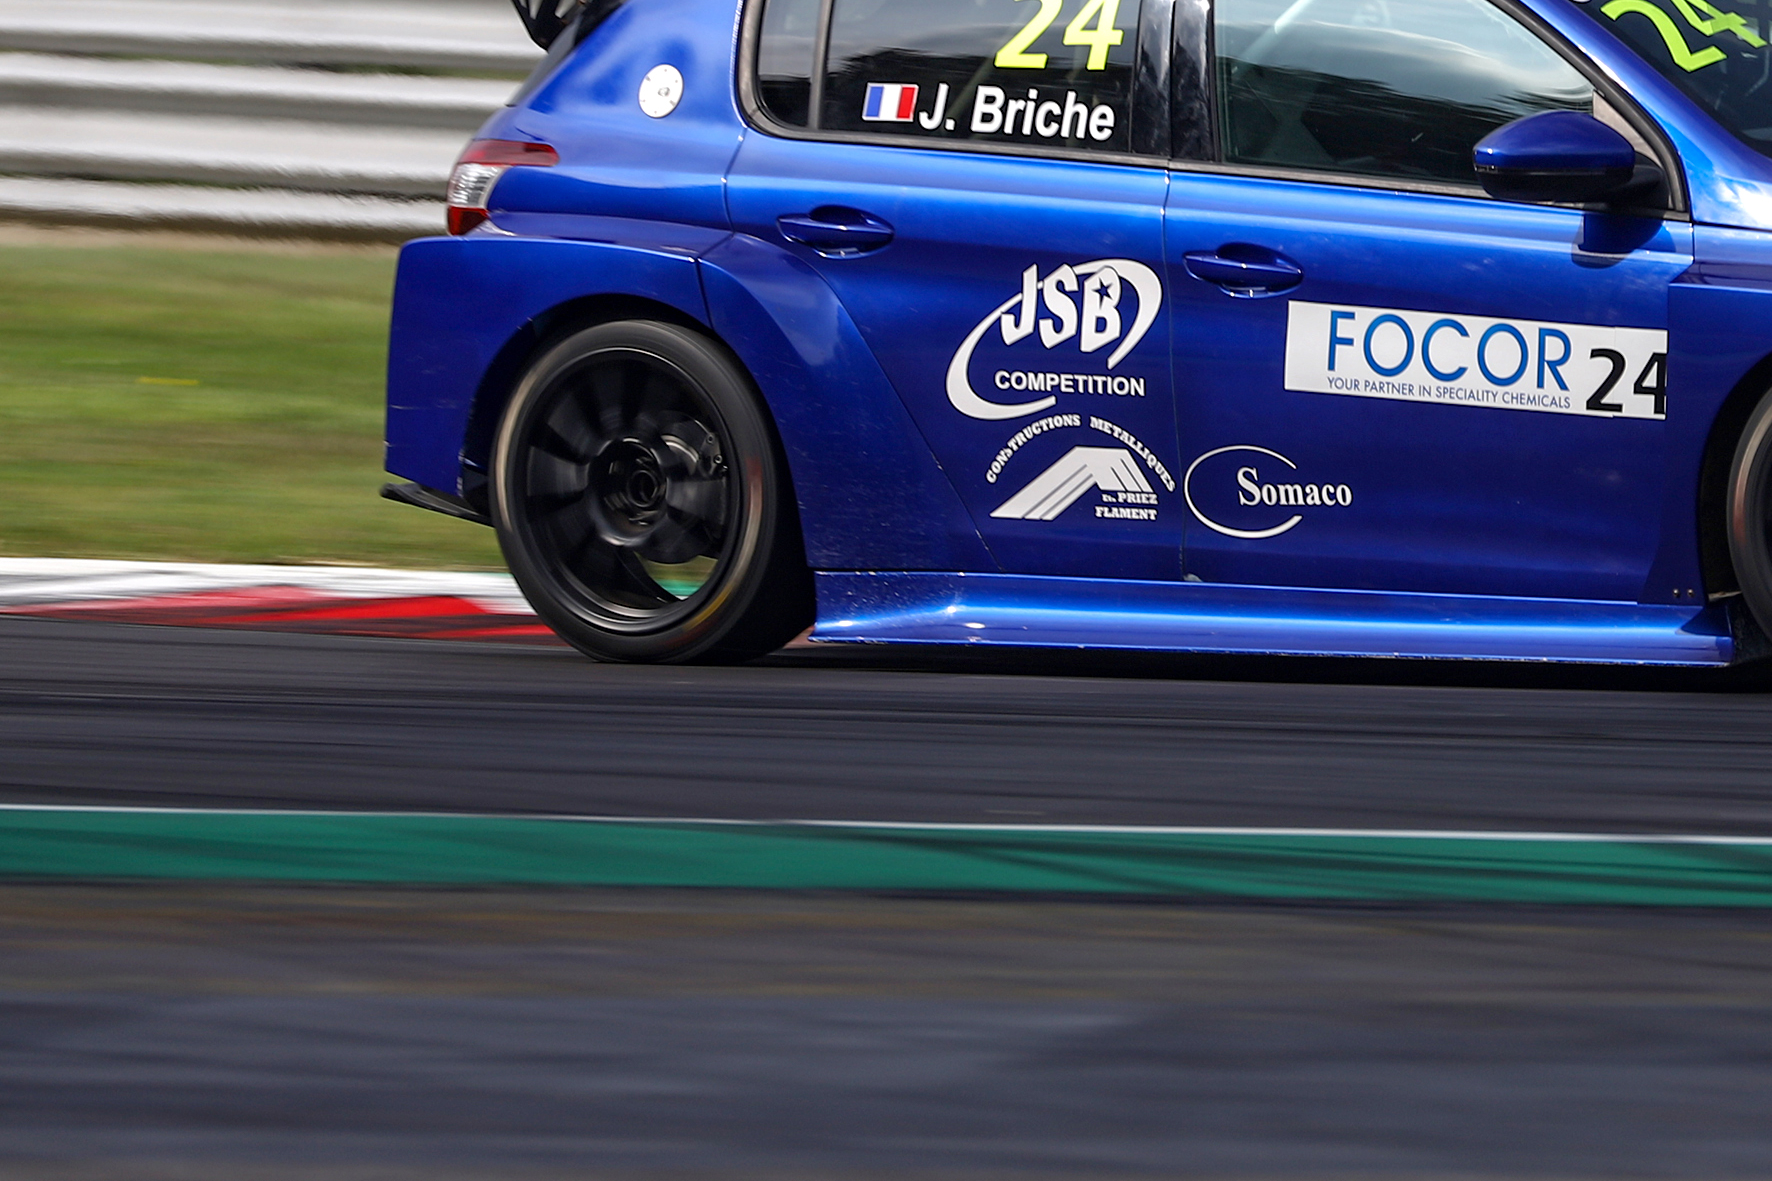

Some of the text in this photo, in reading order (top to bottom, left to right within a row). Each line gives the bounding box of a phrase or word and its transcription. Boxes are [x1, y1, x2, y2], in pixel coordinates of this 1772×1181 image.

[918, 82, 1116, 142] J. Briche
[1000, 262, 1123, 353] JSB
[1327, 309, 1668, 415] FOCOR 24
[994, 368, 1146, 398] COMPETITION
[1327, 376, 1572, 409] YOUR PARTNER IN SPECIALITY CHEMICALS
[986, 413, 1177, 493] CONSTRUCTIONS METALLIQUES
[1117, 492, 1159, 505] PRIEZ
[1236, 466, 1353, 507] Somaco
[1094, 506, 1158, 521] FLAMENT
